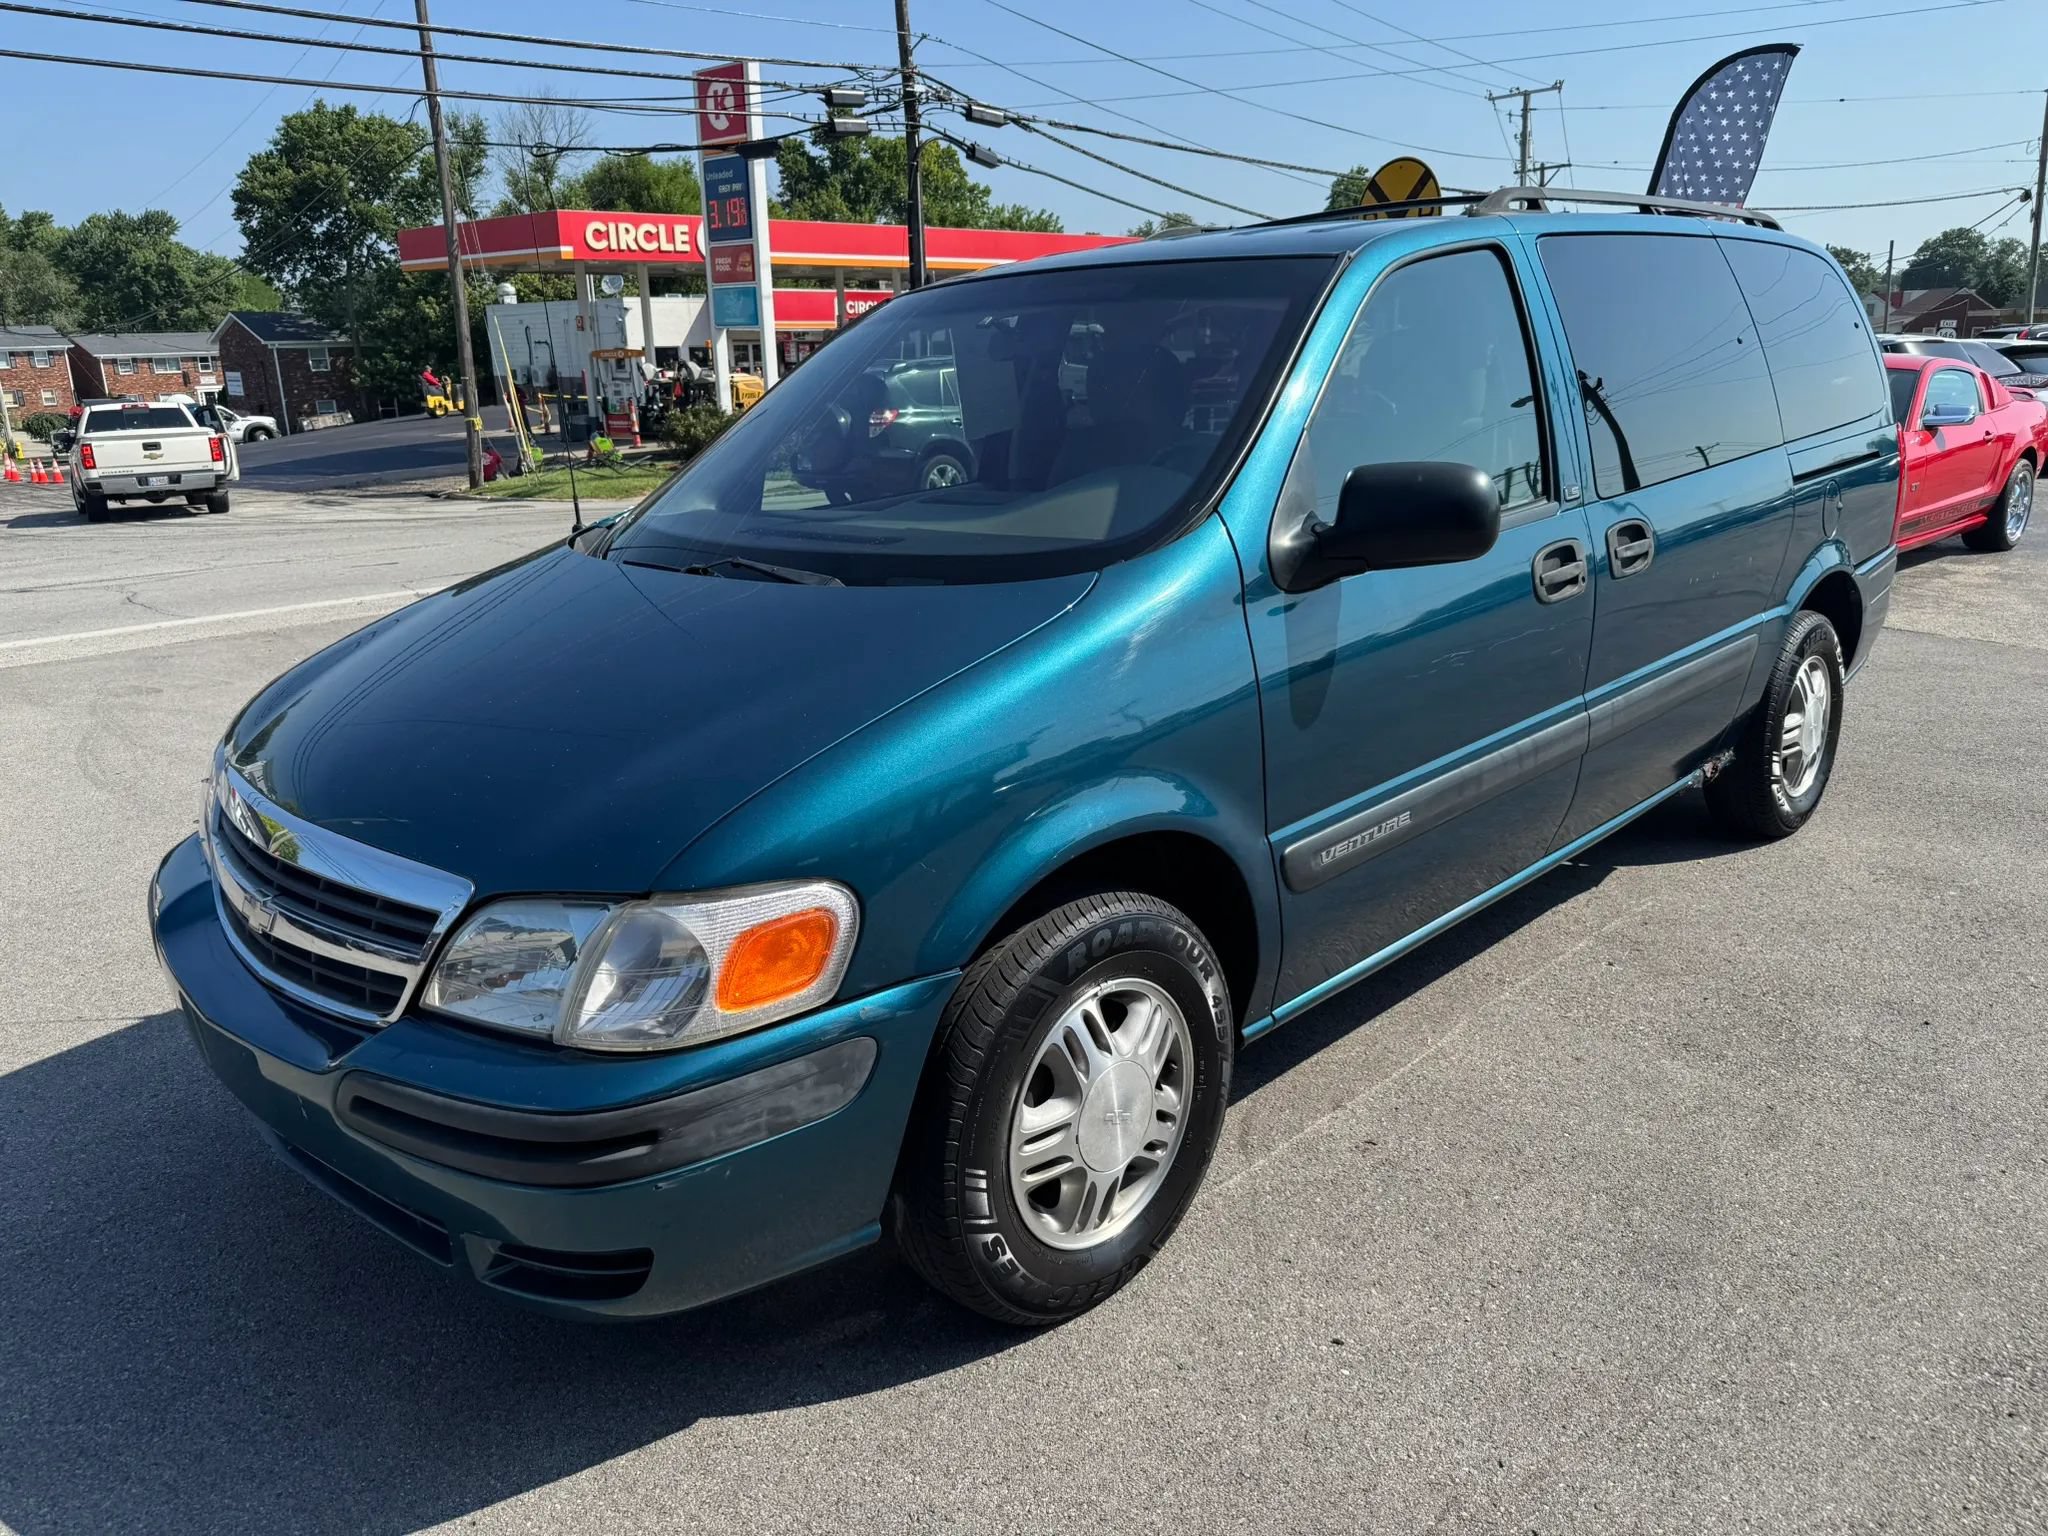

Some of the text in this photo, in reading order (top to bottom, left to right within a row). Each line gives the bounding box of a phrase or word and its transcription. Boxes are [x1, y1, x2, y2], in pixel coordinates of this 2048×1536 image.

[710, 84, 733, 125] K
[706, 169, 733, 180] Unleaded
[585, 221, 691, 252] CIRCLE
[715, 256, 731, 265] FRESH
[846, 300, 878, 314] CIRC
[1320, 811, 1411, 865] VENTURE
[1211, 995, 1227, 1042] 455
